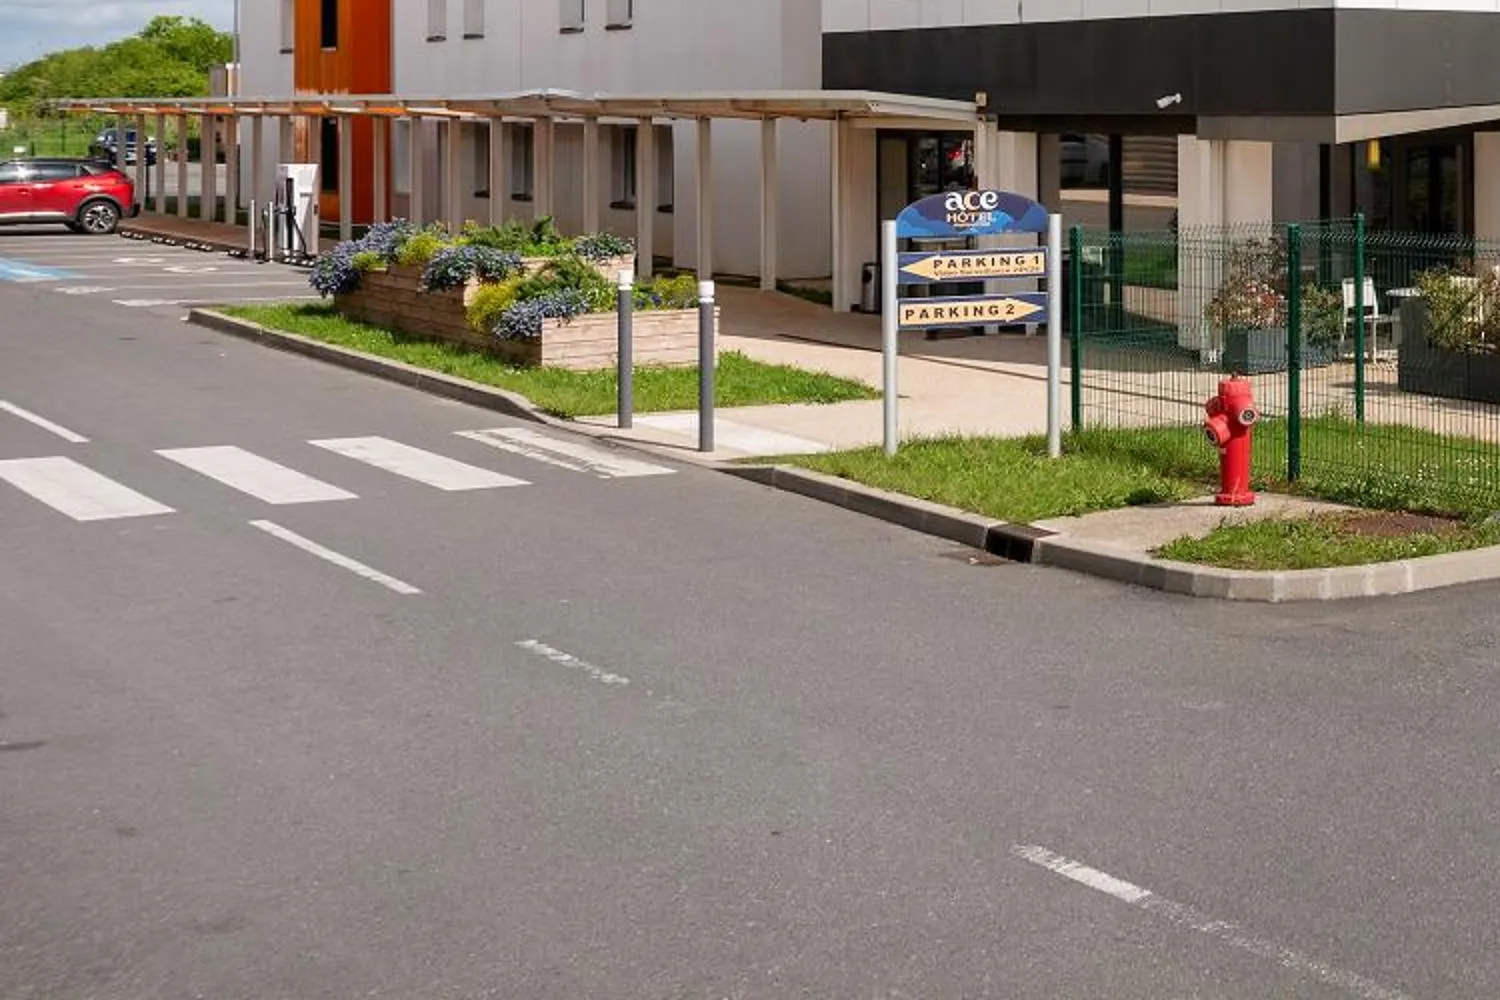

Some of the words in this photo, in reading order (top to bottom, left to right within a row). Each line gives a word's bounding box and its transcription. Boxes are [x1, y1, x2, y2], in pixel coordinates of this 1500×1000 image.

[945, 191, 999, 211] ace
[933, 256, 1026, 269] PARKING
[1034, 255, 1040, 265] 1
[905, 305, 1000, 320] PARKING
[1006, 303, 1016, 316] 2
